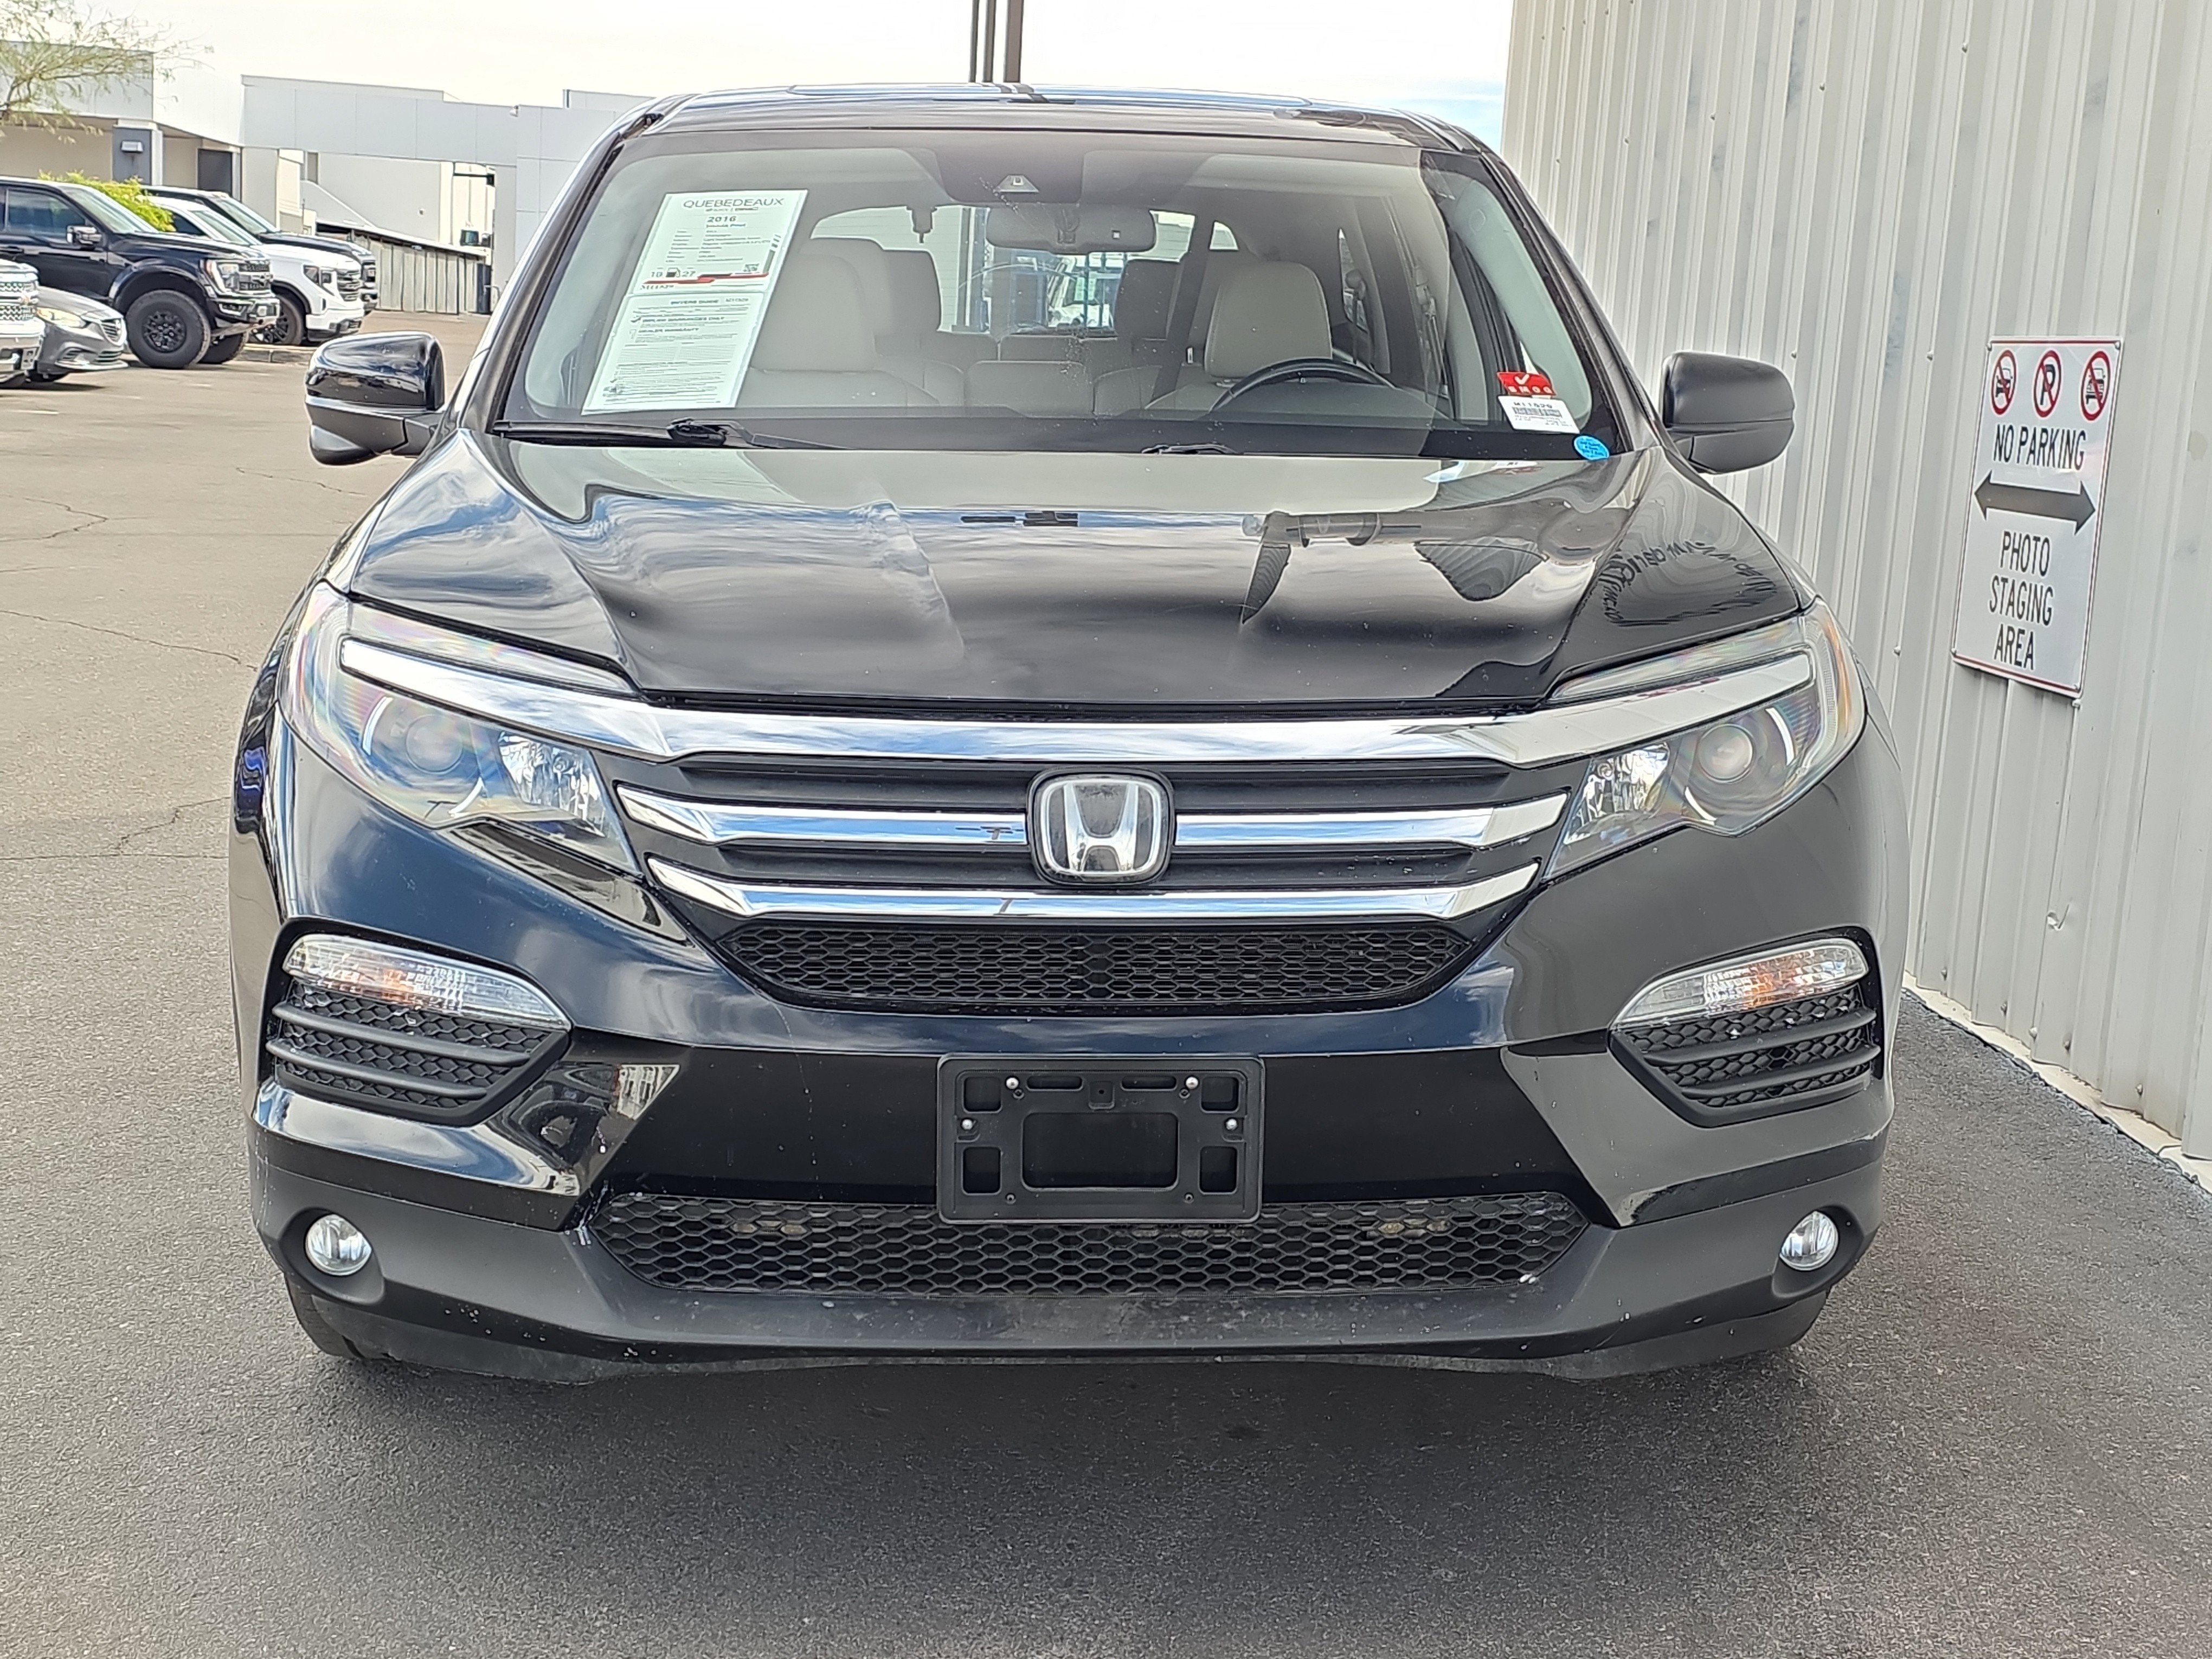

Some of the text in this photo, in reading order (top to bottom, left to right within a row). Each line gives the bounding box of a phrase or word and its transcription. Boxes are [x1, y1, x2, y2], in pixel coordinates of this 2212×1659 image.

[683, 198, 785, 208] QUEBEDEAUX
[1994, 425, 2086, 471] NO PARKING
[2000, 531, 2050, 576] PHOTO
[1990, 576, 2053, 626] STAGING
[1994, 626, 2034, 670] AREA
